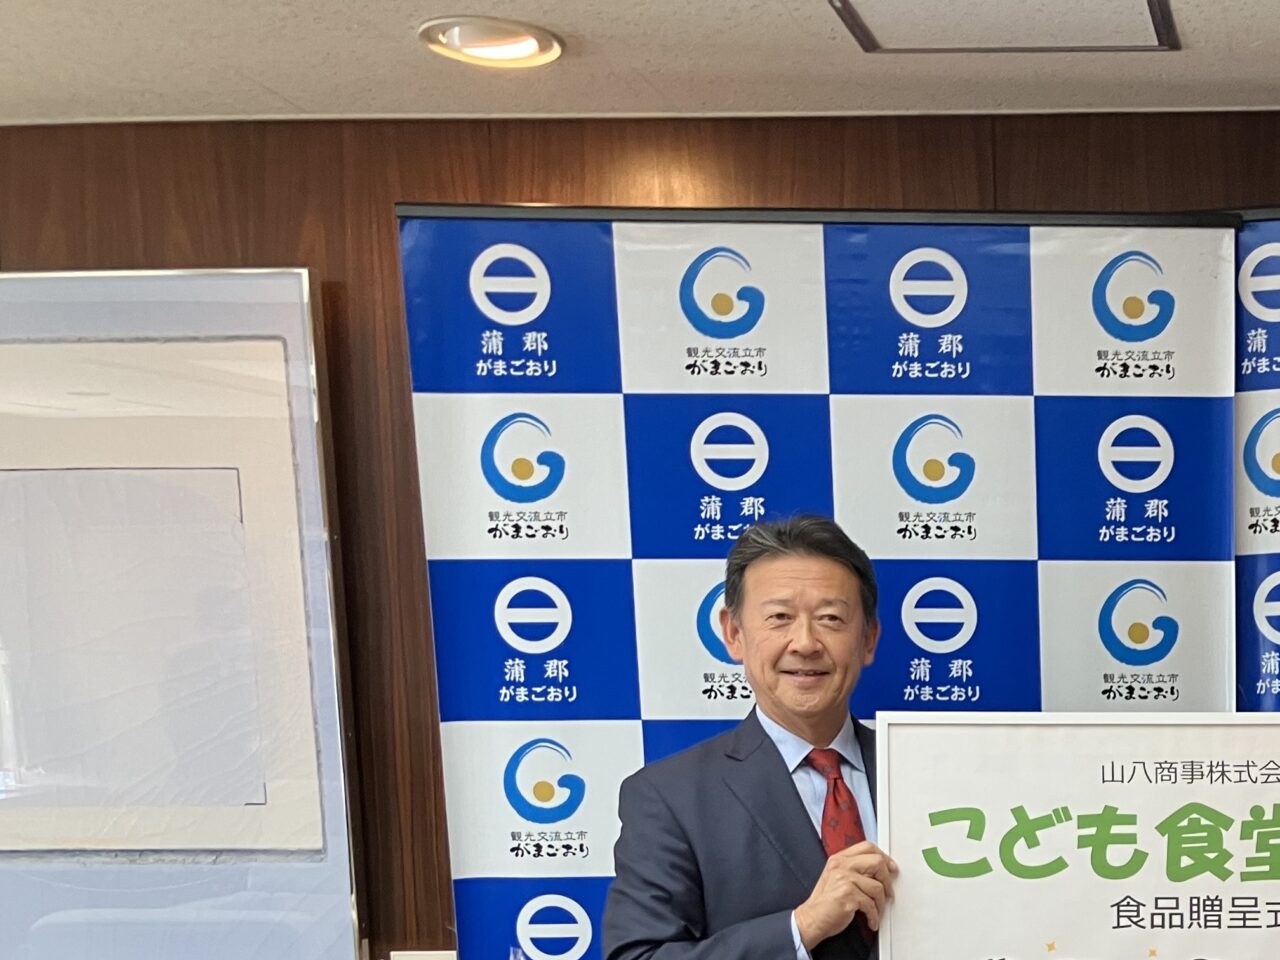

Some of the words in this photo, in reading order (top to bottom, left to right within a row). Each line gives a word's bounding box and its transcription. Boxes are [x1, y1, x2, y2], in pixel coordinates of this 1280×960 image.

[481, 330, 548, 355] 蒲郡
[898, 333, 963, 358] 蒲郡
[686, 347, 767, 359] 観光交流立市
[1097, 350, 1175, 361] 観光交流立市
[476, 359, 557, 377] がまごおり
[685, 359, 768, 377] がまごおり
[891, 361, 970, 379] がまごおり
[1095, 363, 1176, 381] がまごおり
[488, 511, 568, 522] 観光交流立市
[700, 496, 765, 519] 蒲郡
[1105, 498, 1169, 522] 蒲郡
[898, 511, 976, 523] 観光交流立市
[487, 522, 569, 540] がまごおり
[694, 524, 750, 540] がまご
[897, 523, 977, 541] がまごおり
[1099, 524, 1176, 543] がまごおり
[504, 659, 568, 681] 蒲郡
[910, 658, 973, 681] 蒲郡
[1103, 673, 1179, 684] 観光交流立市
[499, 686, 577, 702] がまごおり
[702, 685, 752, 700] がまご
[904, 684, 980, 701] がまごおり
[1101, 685, 1179, 701] がまごおり
[511, 831, 588, 842] 観光交流立市
[510, 843, 589, 858] がまごおり
